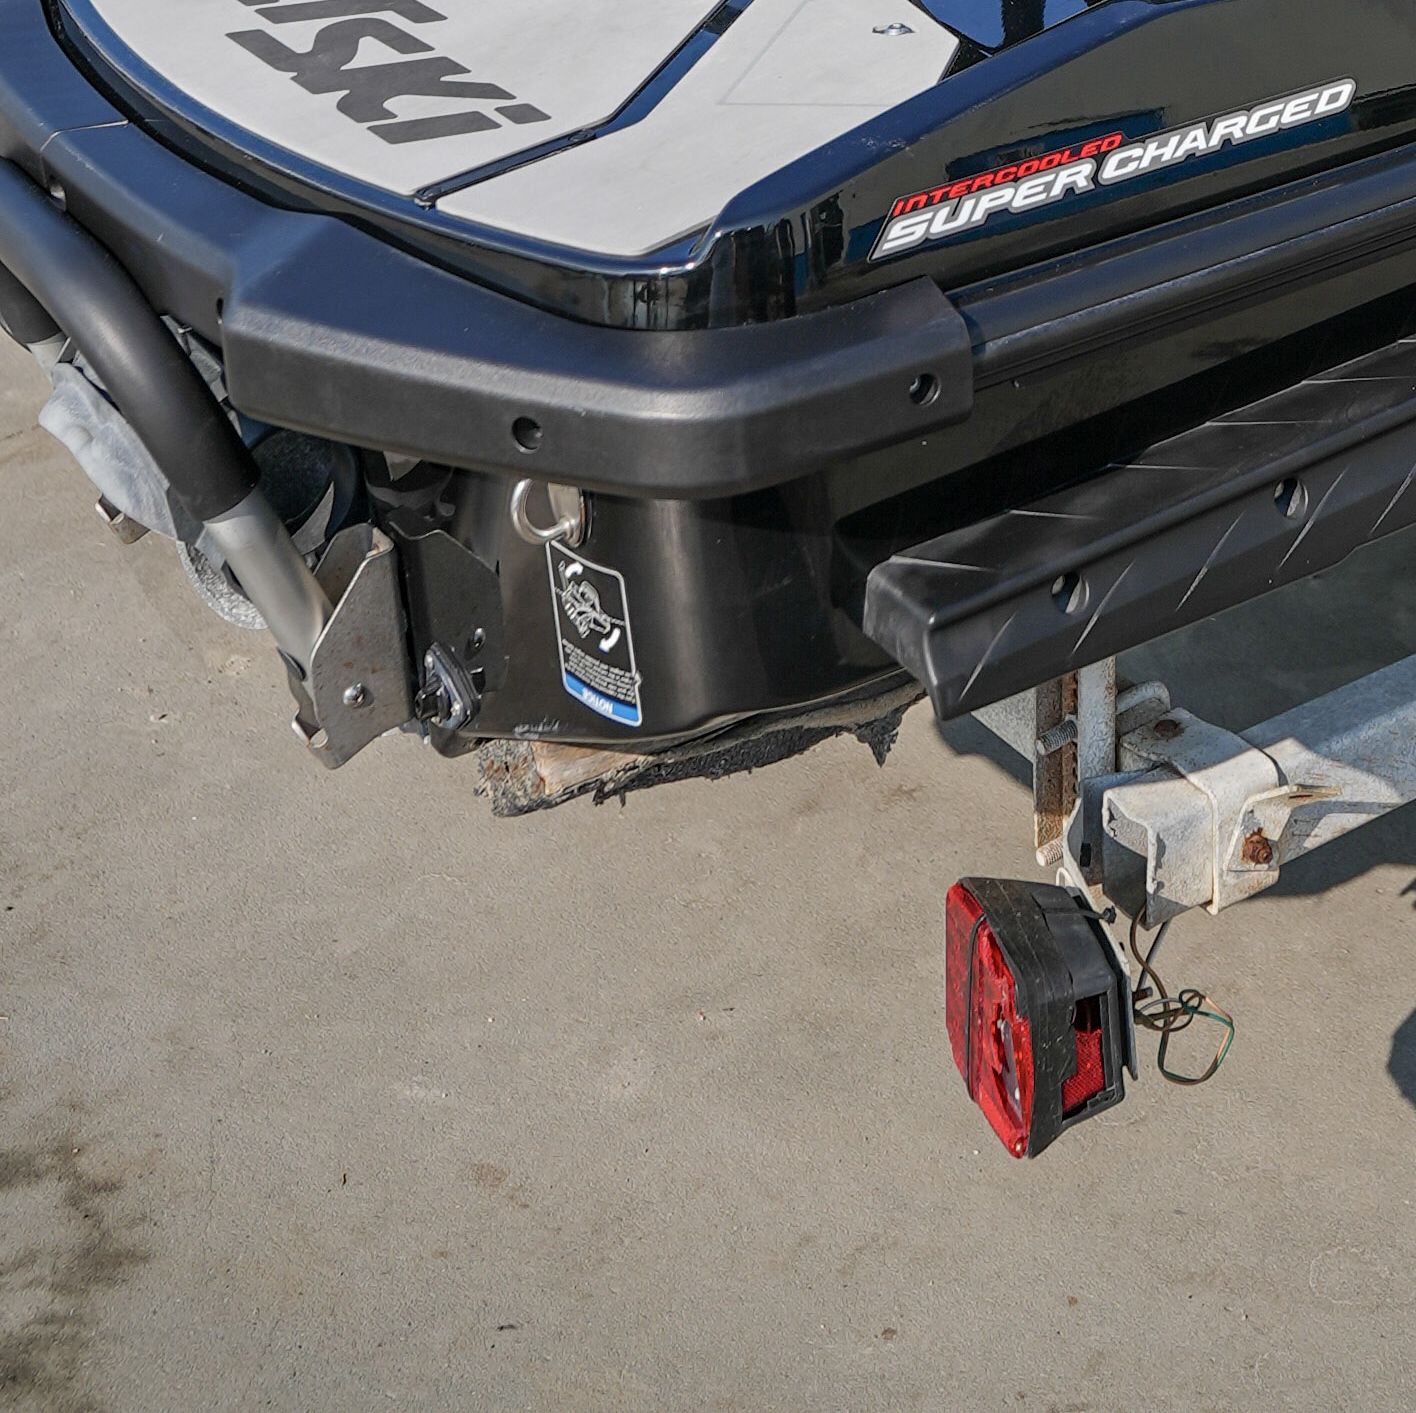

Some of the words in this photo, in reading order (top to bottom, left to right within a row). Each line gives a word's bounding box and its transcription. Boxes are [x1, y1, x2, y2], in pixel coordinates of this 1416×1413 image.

[882, 163, 1095, 251] SUPER
[1105, 82, 1354, 181] CHARGED
[893, 132, 1124, 218] INTERCOOLED
